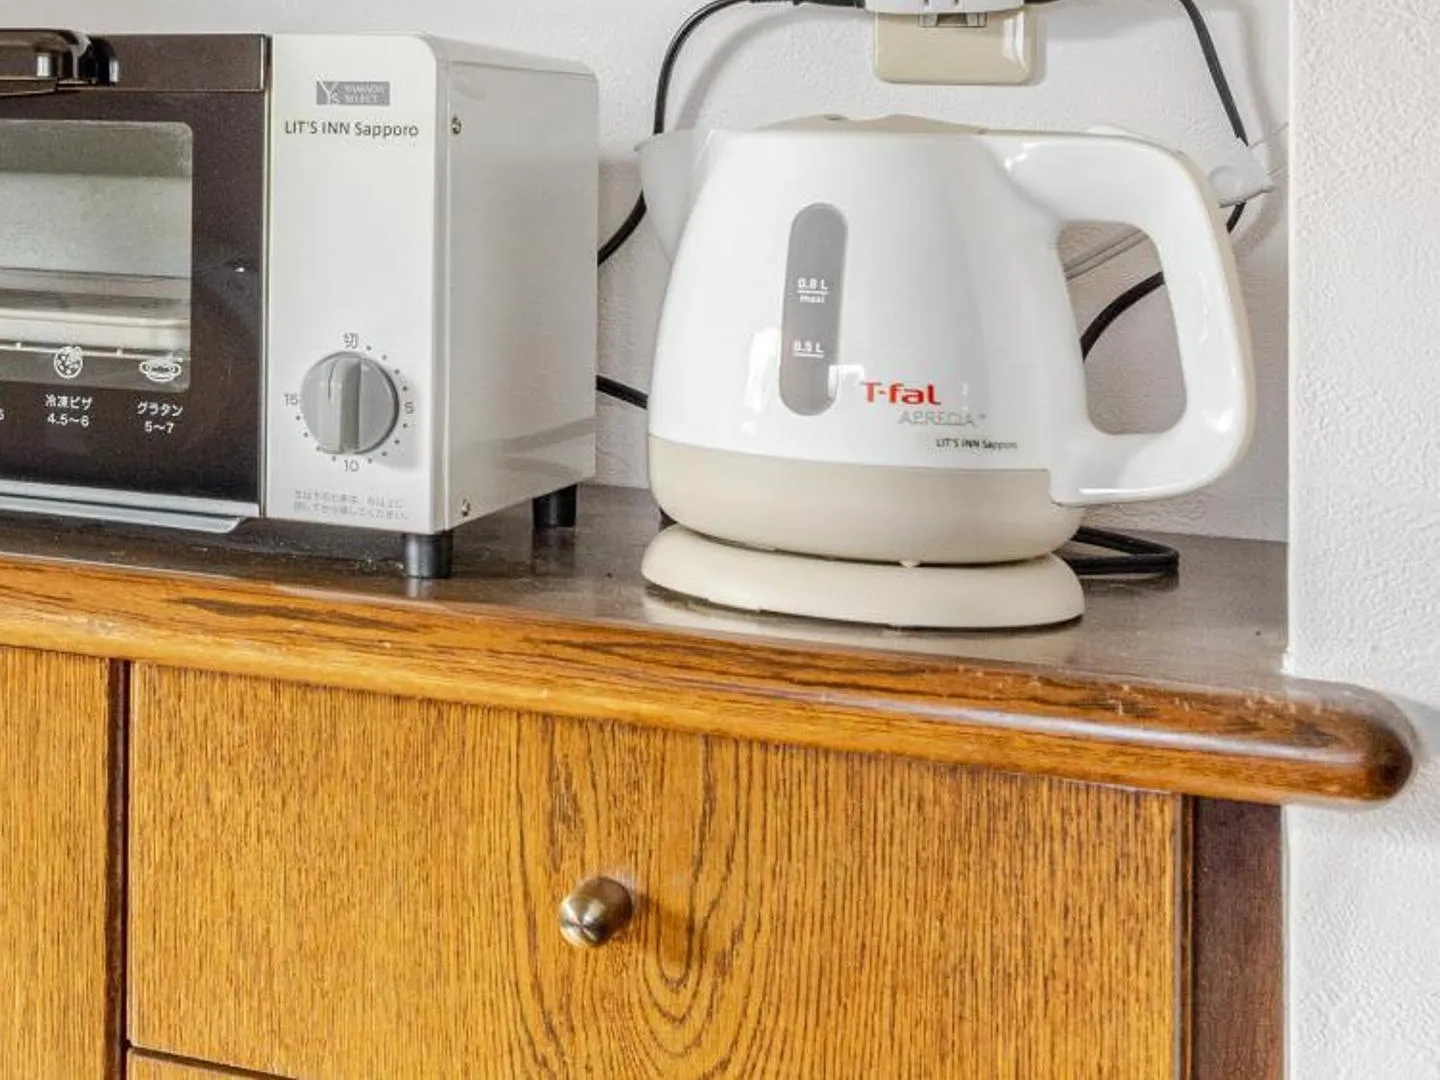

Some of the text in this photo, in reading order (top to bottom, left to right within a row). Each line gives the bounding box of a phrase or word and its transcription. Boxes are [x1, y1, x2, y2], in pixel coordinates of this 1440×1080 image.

[284, 121, 420, 138] LIT'S INN Sapporo
[285, 393, 299, 406] 15
[860, 381, 942, 406] T-fal
[137, 401, 184, 417] グラタン
[344, 459, 359, 472] 10
